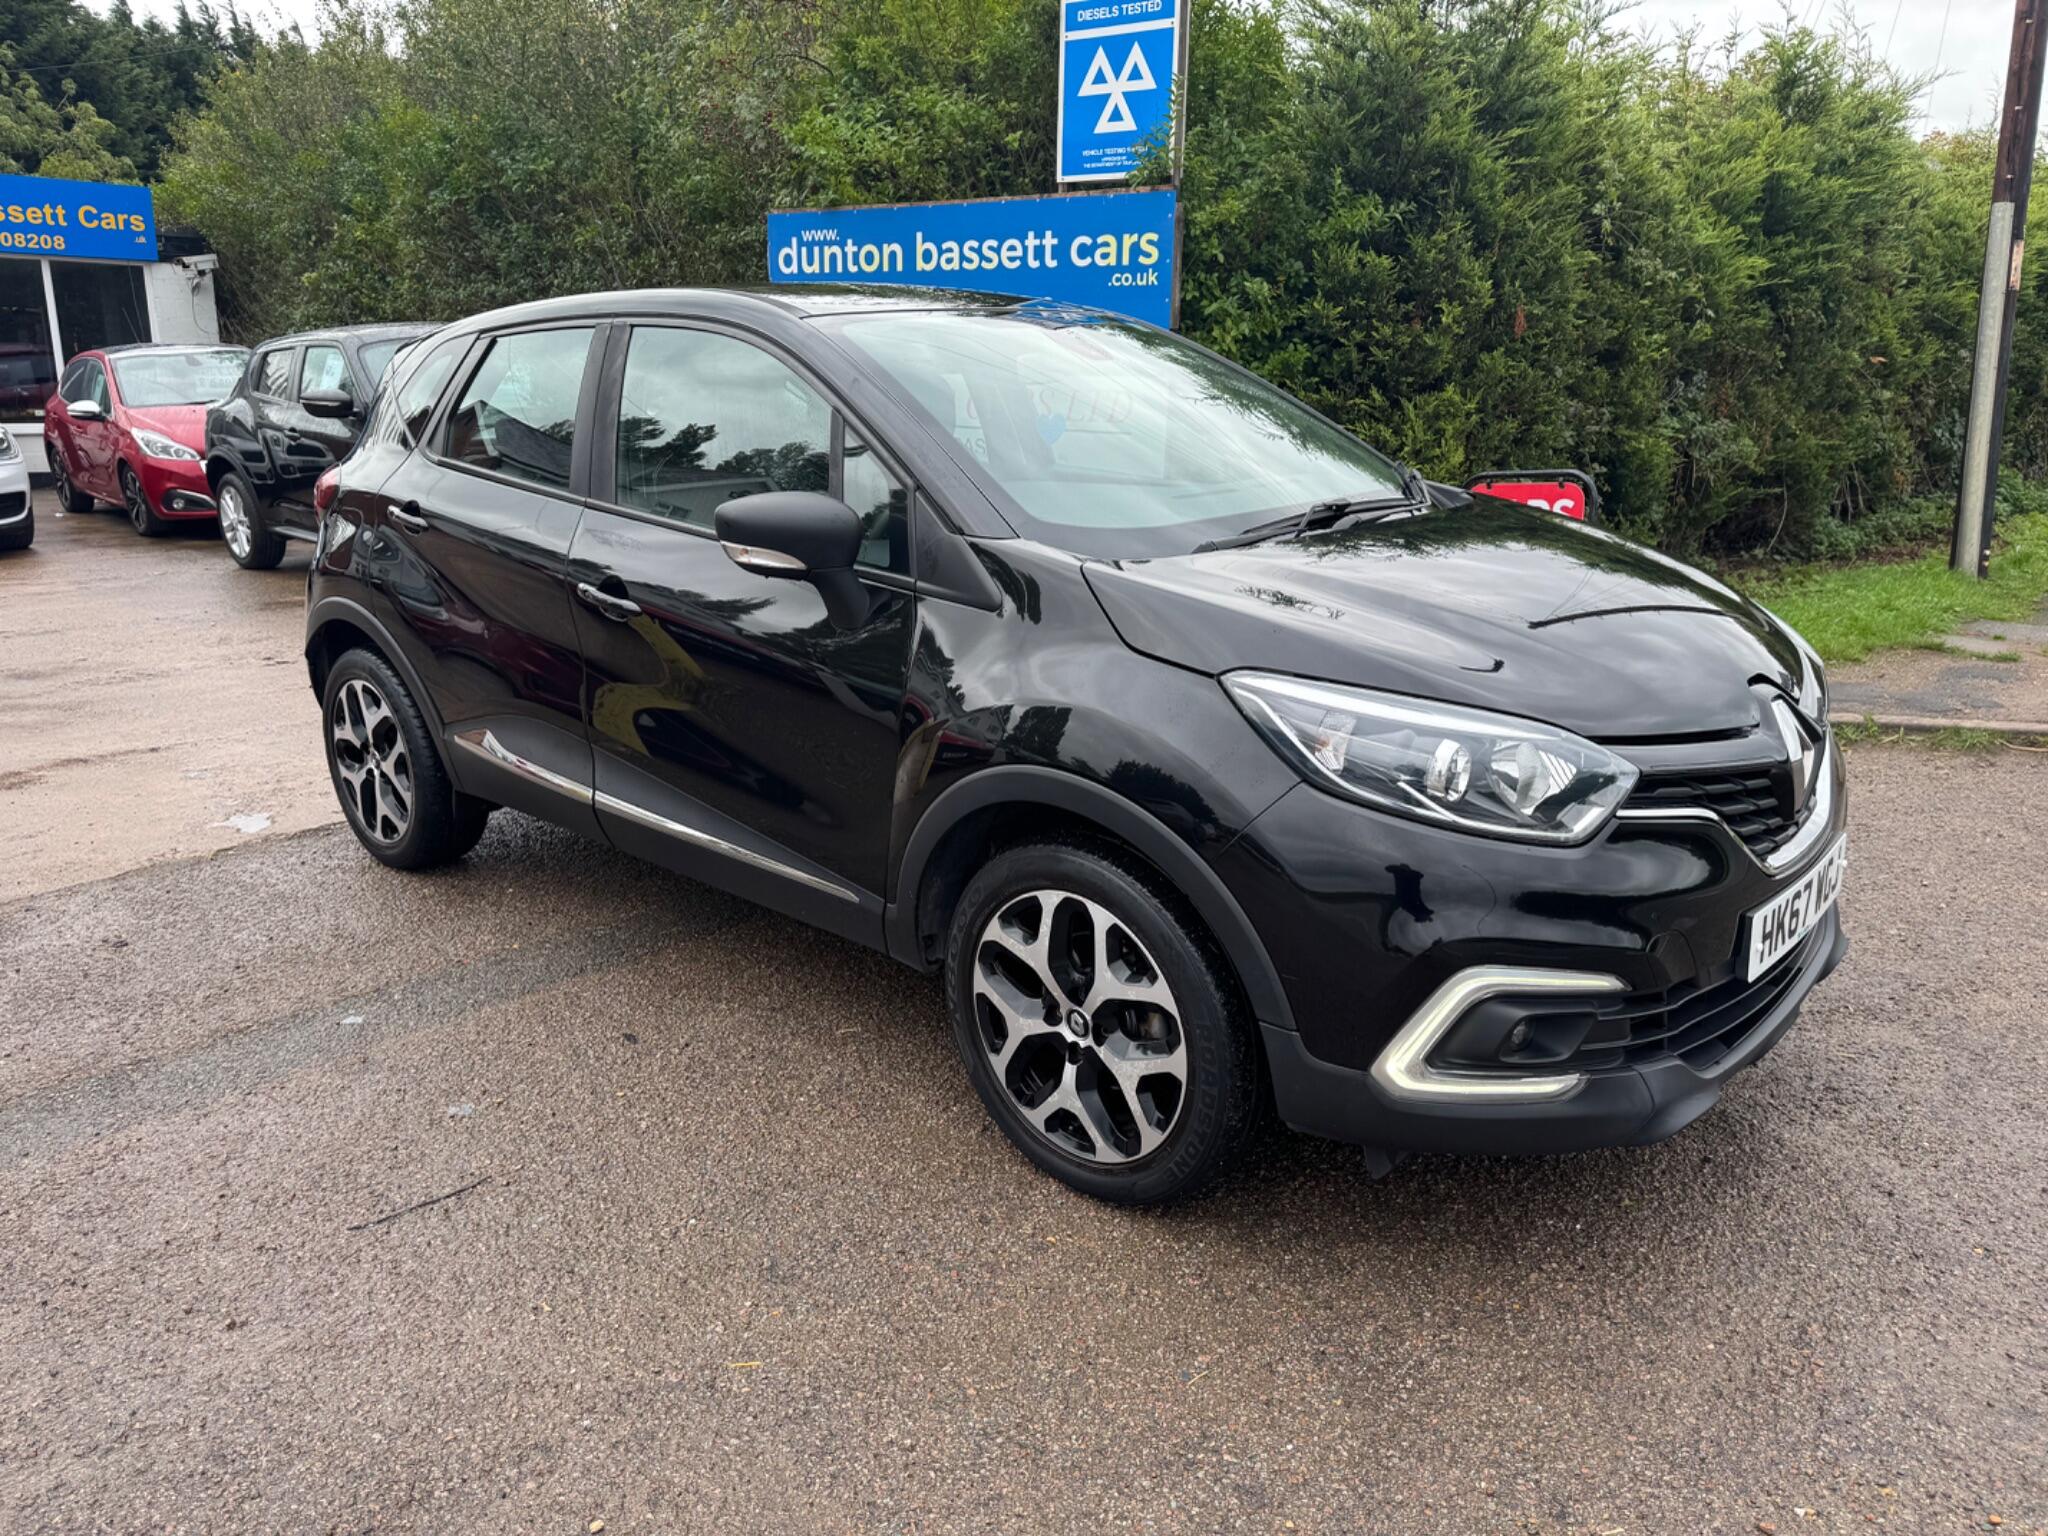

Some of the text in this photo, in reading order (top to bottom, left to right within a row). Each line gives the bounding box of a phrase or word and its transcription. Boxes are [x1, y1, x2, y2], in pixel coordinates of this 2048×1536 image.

[1077, 0, 1162, 22] DIESELS TESTED
[78, 205, 145, 231] Cars
[0, 231, 65, 250] 08208
[801, 228, 840, 242] www.
[778, 230, 1160, 274] dunton bassett cars
[1108, 268, 1159, 287] .co.uk
[1760, 878, 1814, 965] HK67
